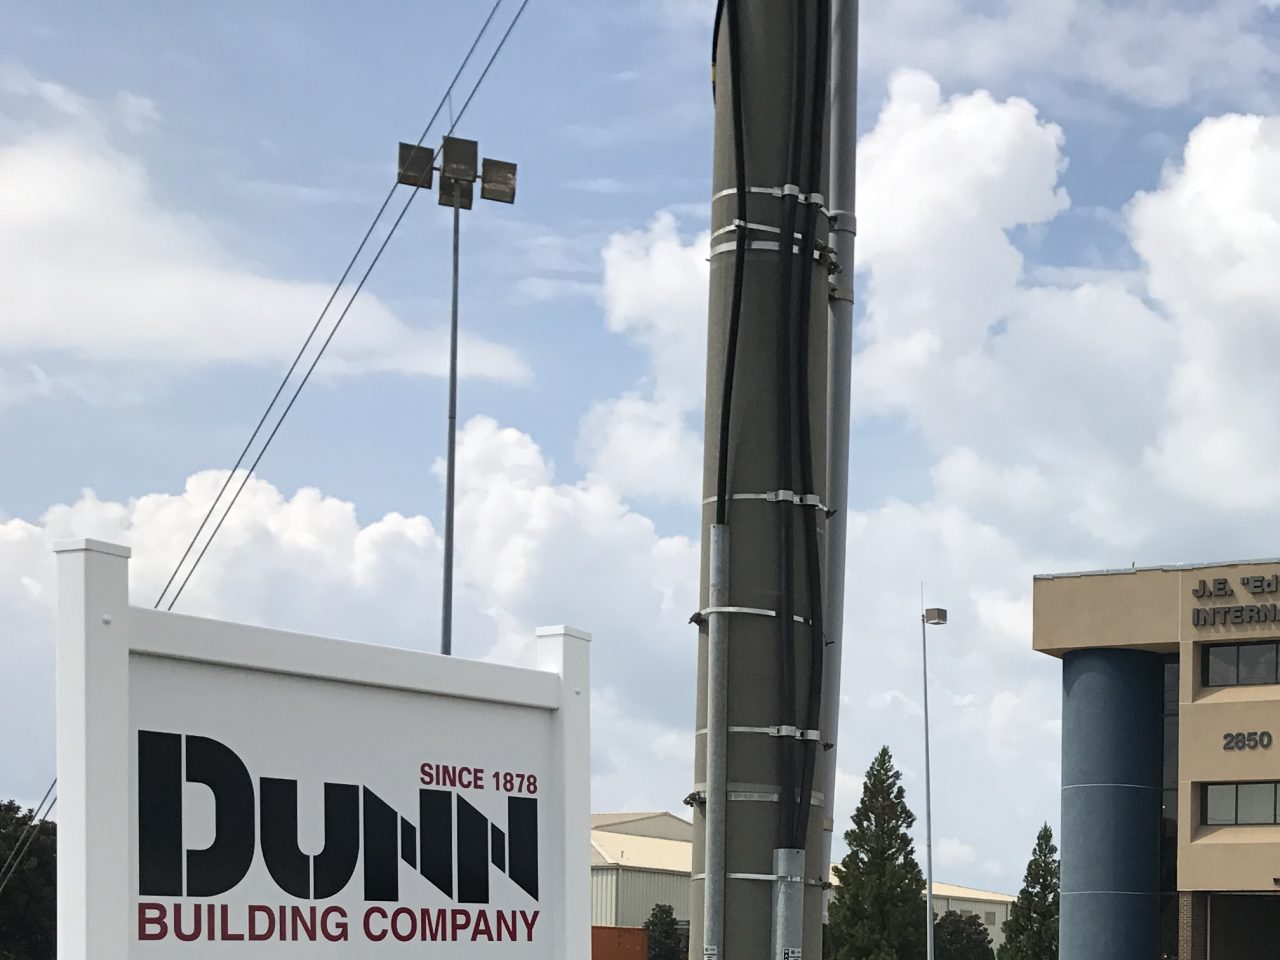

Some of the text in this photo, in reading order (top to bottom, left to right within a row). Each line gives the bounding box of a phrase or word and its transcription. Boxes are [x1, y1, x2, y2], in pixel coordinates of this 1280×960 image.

[1192, 578, 1234, 598] J.E.
[1223, 731, 1273, 751] 2850
[419, 762, 538, 795] SINCE 1878
[138, 903, 541, 943] BUILDING COMPANY
